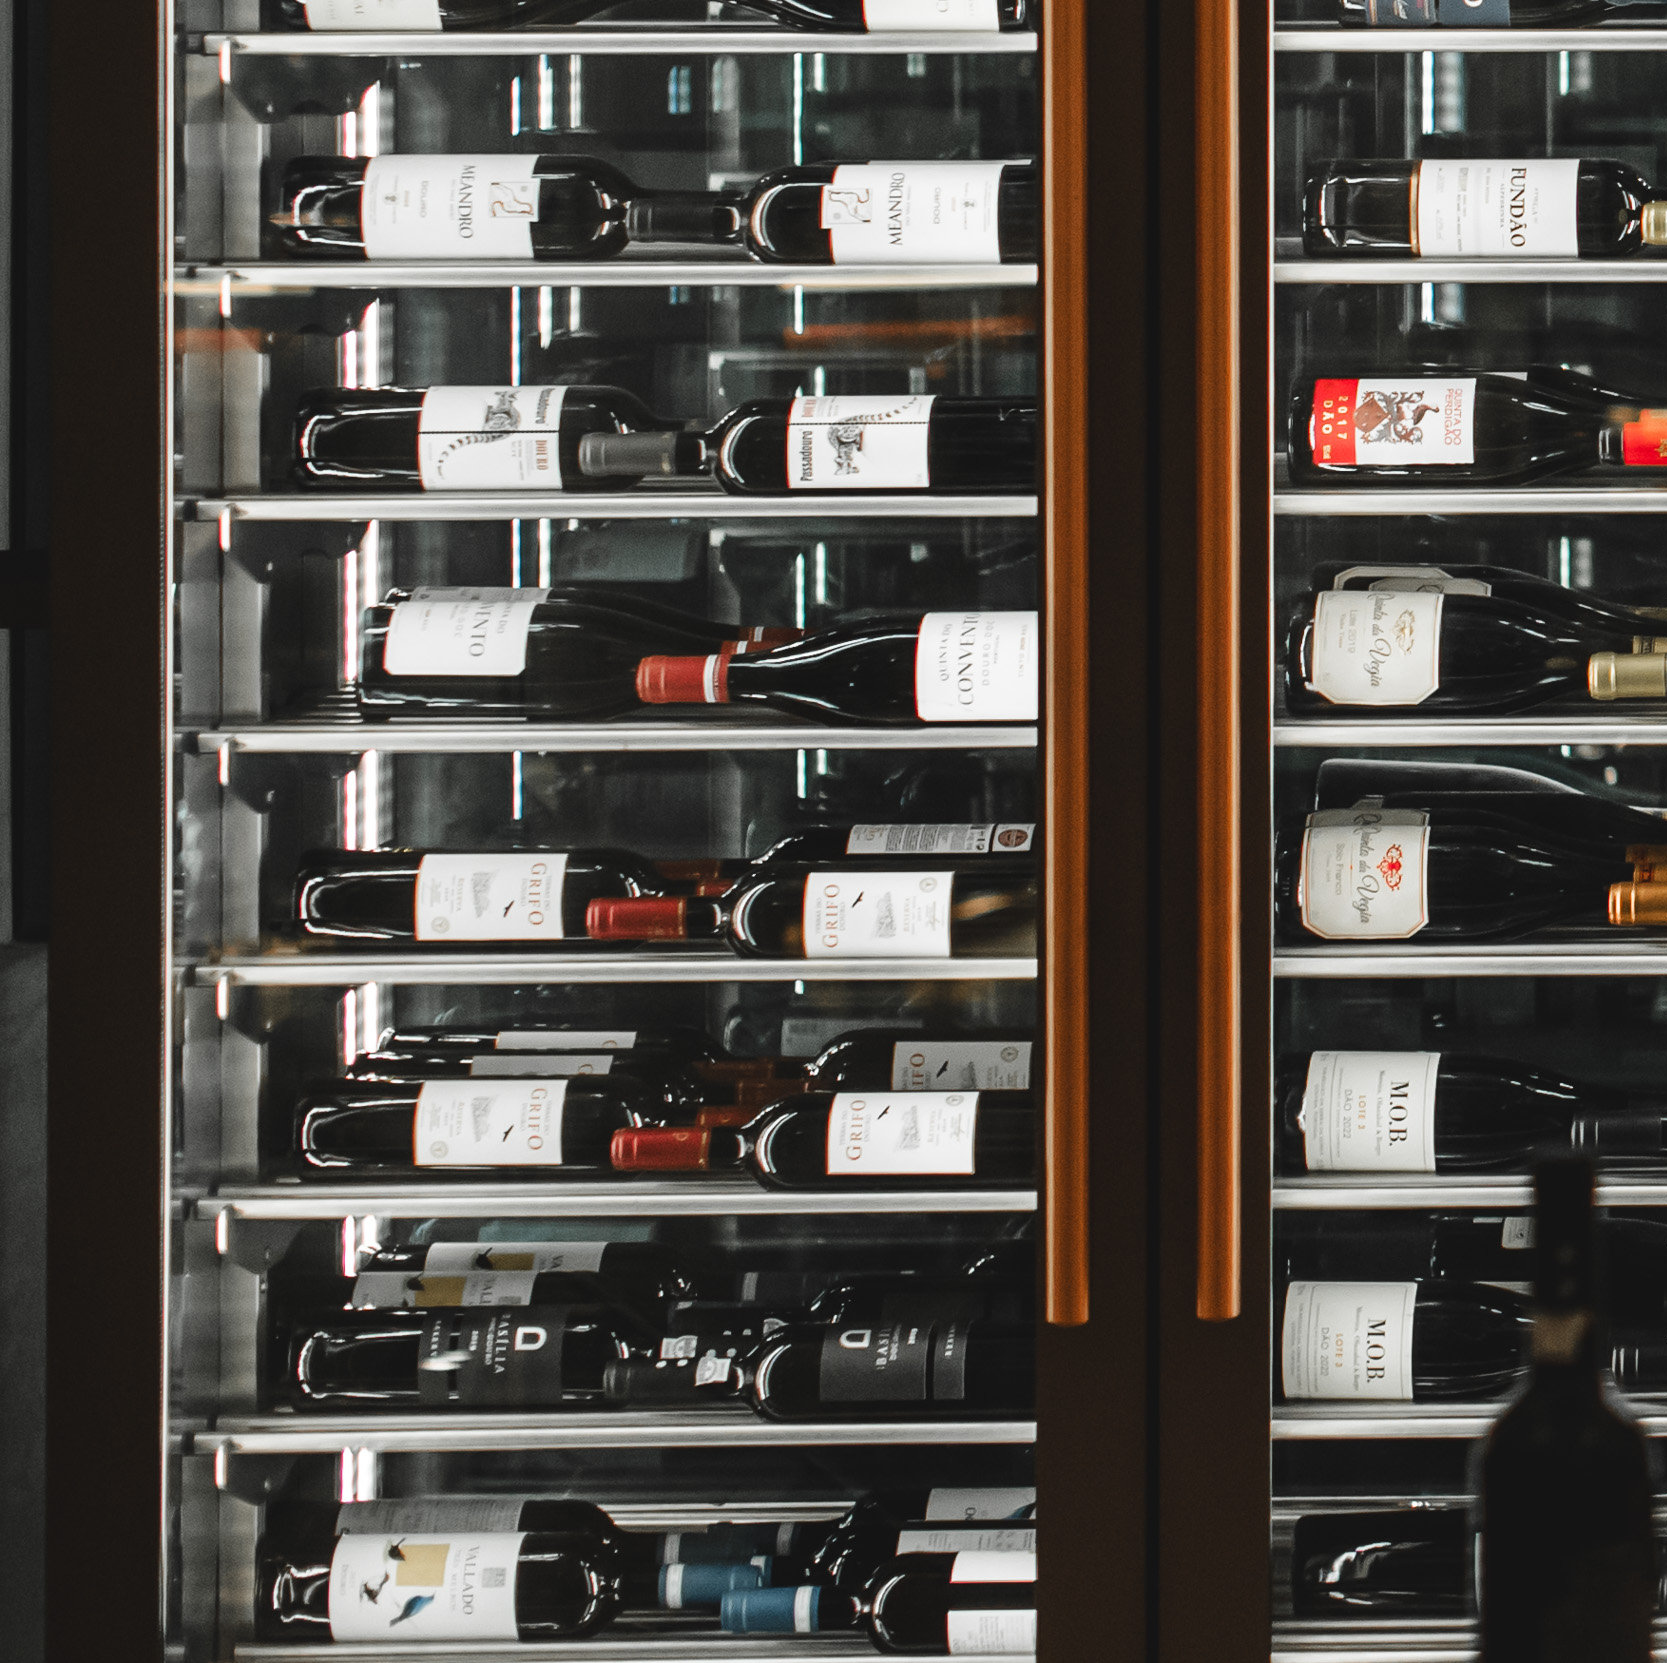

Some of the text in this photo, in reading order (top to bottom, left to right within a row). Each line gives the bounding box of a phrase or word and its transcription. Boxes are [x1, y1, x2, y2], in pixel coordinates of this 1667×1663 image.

[458, 166, 476, 238] MEANDRO
[888, 173, 905, 246] MEANDRO
[1509, 167, 1529, 247] FUNDÃO
[1321, 400, 1335, 434] DÃO
[1337, 396, 1348, 440] 2017
[1444, 388, 1456, 445] PERDIGÃO
[1452, 388, 1463, 445] QUINTA DO
[799, 430, 813, 481] Passadouro
[1347, 630, 1357, 654] 2019
[1363, 638, 1391, 687] Vegia
[528, 862, 547, 925] GRIFO
[1335, 843, 1345, 895] Solo Franco
[1352, 860, 1380, 924] da Vegia
[823, 884, 841, 948] GRIFO
[527, 1088, 548, 1150] GRIFO
[845, 1100, 866, 1161] GRIFO
[1343, 1089, 1355, 1139] DÃO 2022
[1358, 1095, 1367, 1120] LOTE
[1388, 1081, 1410, 1147] M.O.B.
[1320, 1327, 1331, 1376] DÃO 2022
[1334, 1333, 1344, 1358] LOTE
[1366, 1319, 1387, 1383] M.O.B.
[462, 1546, 480, 1615] VALLADO
